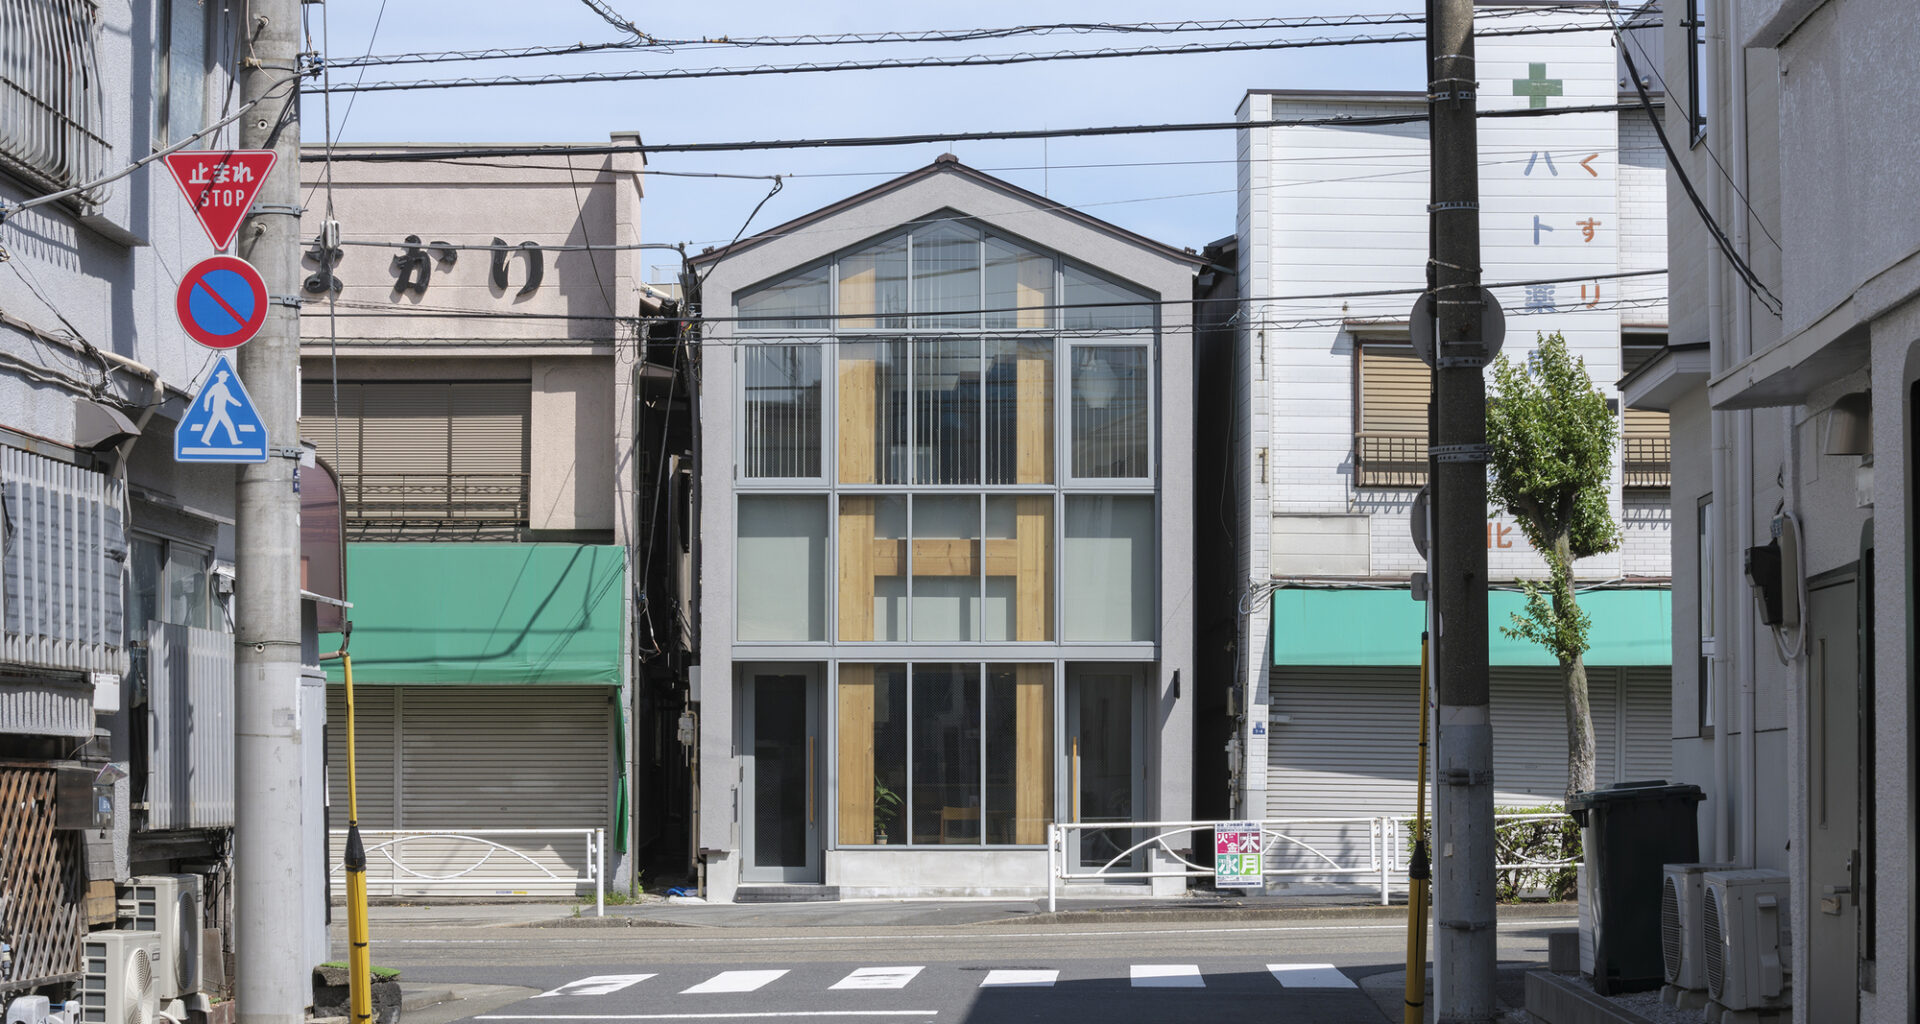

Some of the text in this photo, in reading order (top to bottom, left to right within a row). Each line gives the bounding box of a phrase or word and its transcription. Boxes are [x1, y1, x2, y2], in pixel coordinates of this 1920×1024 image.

[189, 162, 254, 184] 止まれ
[201, 190, 245, 207] STOP
[1575, 152, 1602, 309] くすり
[1217, 832, 1229, 844] 火
[1239, 832, 1260, 853] 木
[1218, 854, 1239, 875] 水
[1240, 854, 1259, 874] 月
